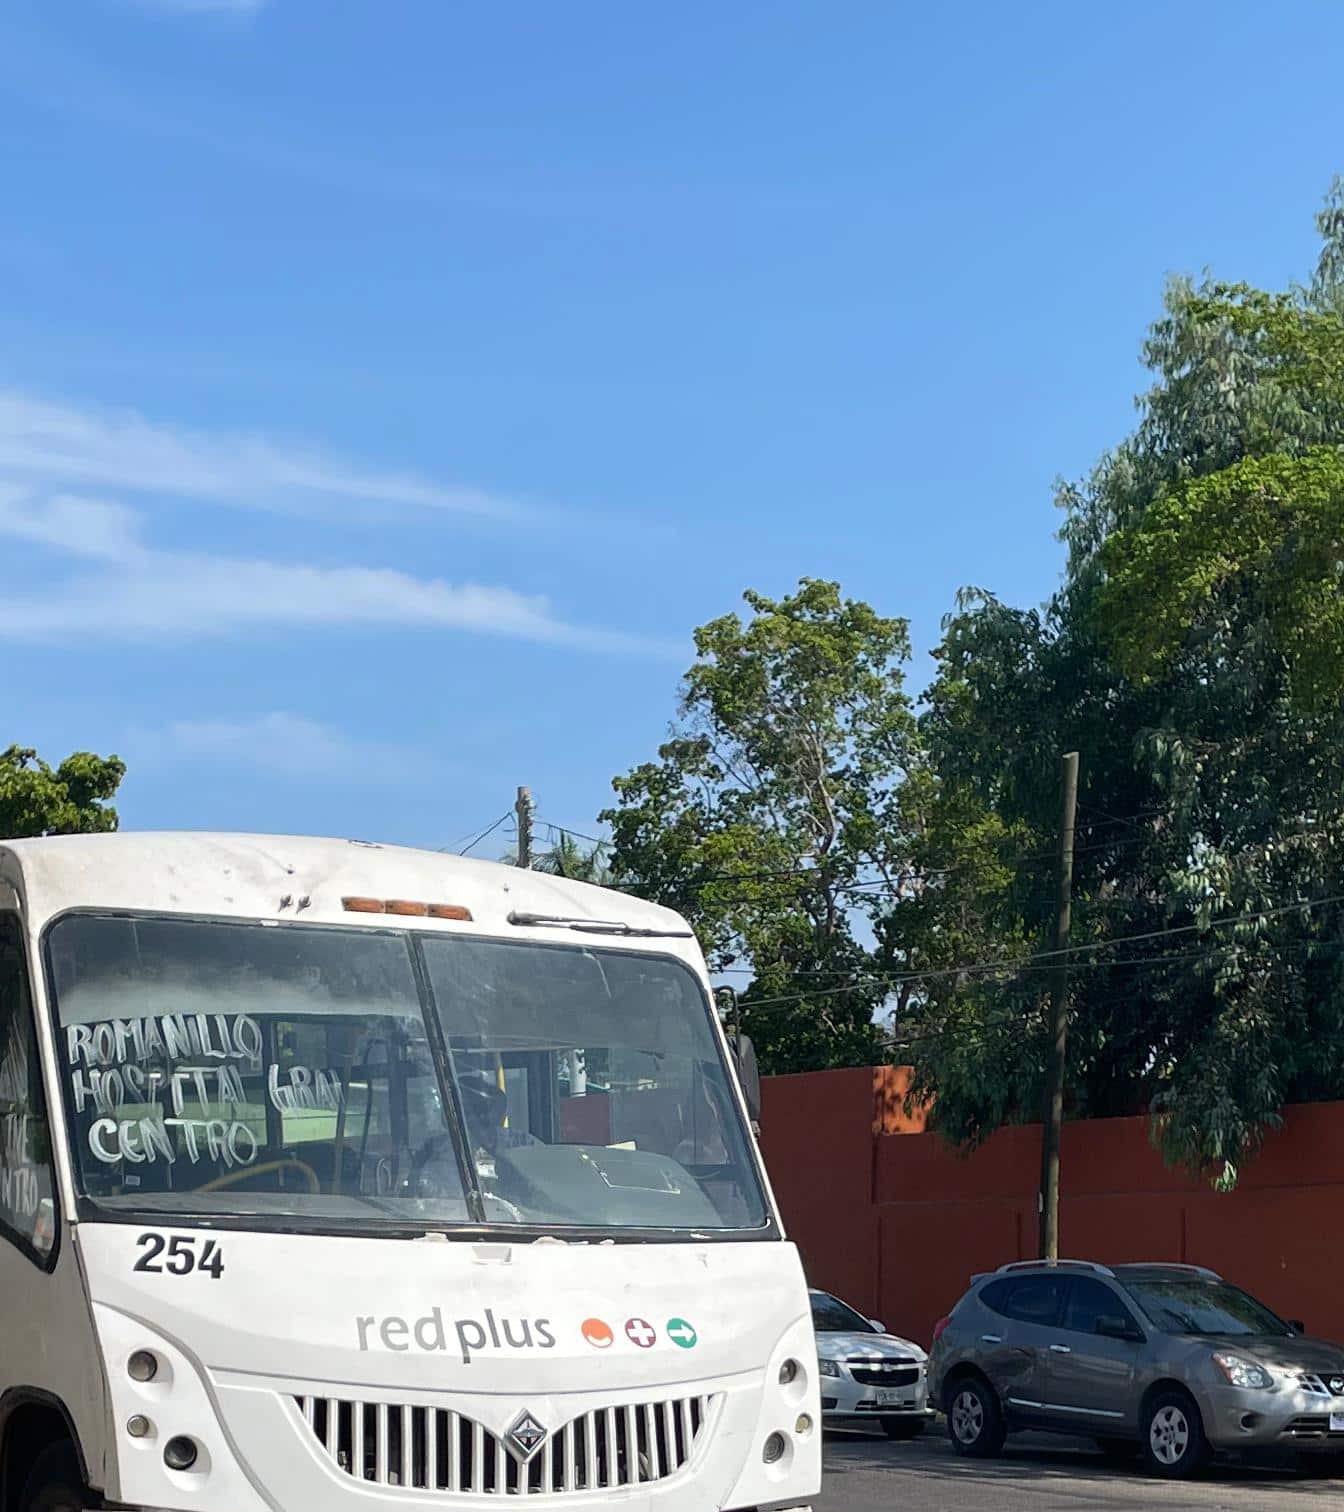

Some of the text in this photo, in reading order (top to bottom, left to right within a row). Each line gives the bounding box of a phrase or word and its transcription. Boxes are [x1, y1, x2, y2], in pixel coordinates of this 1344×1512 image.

[67, 1013, 262, 1067] ROMANILLO
[88, 1117, 257, 1168] CENTRO
[133, 1232, 224, 1279] 254
